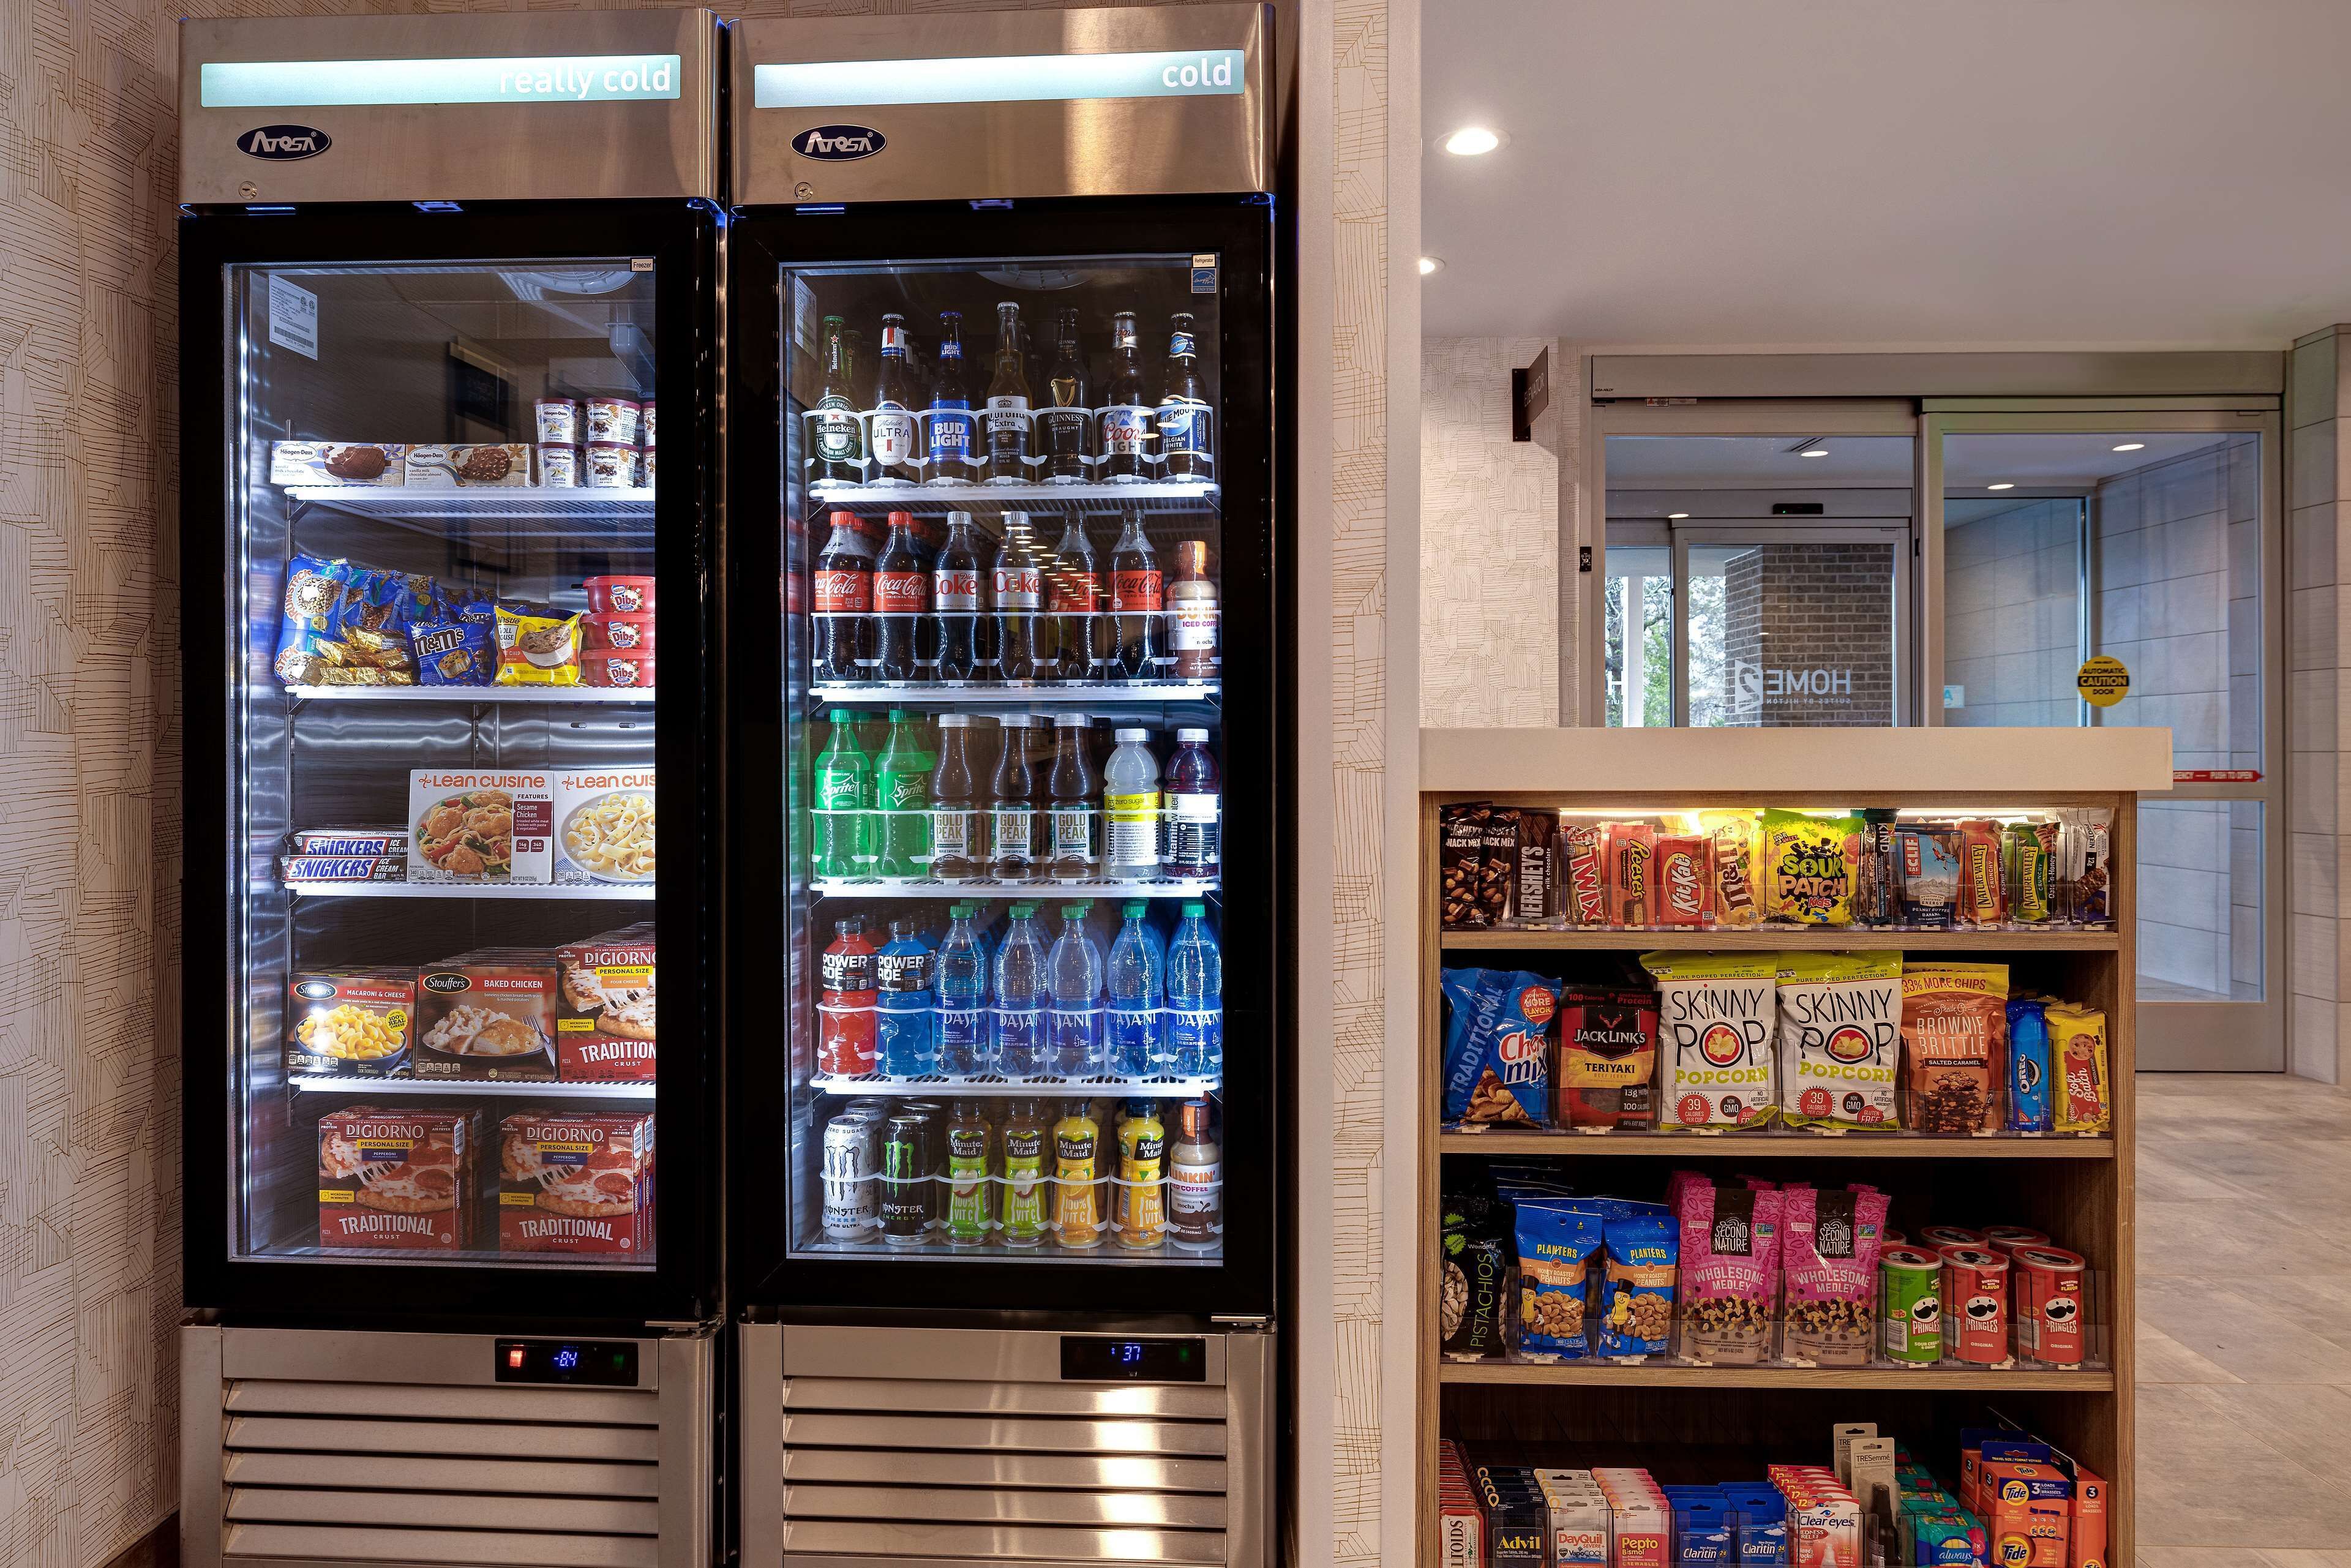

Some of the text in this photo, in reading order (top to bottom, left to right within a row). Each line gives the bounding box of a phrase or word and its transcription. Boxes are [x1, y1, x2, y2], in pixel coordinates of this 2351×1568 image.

[1162, 57, 1232, 88] cold
[499, 62, 670, 99] really cold
[1524, 372, 1545, 407] ELEVATOR
[1048, 415, 1084, 424] GUINNESS
[816, 424, 855, 433] Heineken
[874, 429, 910, 438] ULTRA
[934, 422, 966, 435] BUD
[931, 435, 970, 449] LIGHT
[876, 574, 926, 596] Coca-Cola
[932, 574, 978, 596] Coke
[615, 595, 637, 605] Dibs
[2080, 677, 2127, 686] CAUTION
[894, 784, 926, 799] Sprite
[1000, 813, 1027, 827] GOLD
[1058, 813, 1086, 827] GOLD
[1000, 827, 1028, 839] PEAK
[1059, 827, 1087, 839] PEAK
[1878, 823, 1889, 853] KIND
[1906, 836, 1919, 868] CLIF
[291, 859, 372, 877] SNICKERS
[1782, 855, 1843, 877] SOUR
[1520, 846, 1544, 918] HERSHEY'S
[1779, 875, 1849, 897] PATCH
[1808, 897, 1831, 908] Kids
[822, 953, 868, 968] POWER
[1902, 977, 1987, 993] 33% MORE CHIPS
[1917, 1016, 1984, 1035] BROWNIE
[1574, 1029, 1646, 1043] JACK LINK'S
[1919, 1037, 1986, 1056] BRITTLE
[1584, 1062, 1635, 1074] TERIYAKI
[2019, 1054, 2032, 1095] OREO
[1675, 1066, 1768, 1085] POPCORN
[2069, 1071, 2079, 1097] Soft
[2078, 1067, 2098, 1103] Batch
[1624, 1089, 1638, 1098] 13g
[1687, 1098, 1701, 1111] 39
[1723, 1104, 1739, 1113] GMO
[950, 1139, 981, 1148] Minute
[1060, 1141, 1092, 1150] Minute
[953, 1147, 977, 1156] Maid
[1013, 1147, 1038, 1155] Maid
[1065, 1199, 1086, 1210] 100%
[954, 1210, 973, 1221] VIT C
[339, 1214, 435, 1236] TRADITIONAL
[519, 1219, 613, 1241] TRADITIONAL
[1714, 1224, 1747, 1238] SECOND
[1537, 1244, 1578, 1259] PLANTERS
[1714, 1237, 1748, 1253] NATURE
[1630, 1248, 1667, 1259] PLANTERS
[1540, 1274, 1571, 1285] PEANUTS
[1694, 1266, 1766, 1286] WHOLESOME
[1712, 1280, 1752, 1292] MEDLEY
[1470, 1253, 1493, 1347] PISTACHIOS
[2045, 1319, 2077, 1335] PRINGLES
[1123, 1346, 1141, 1361] 37
[1856, 1454, 1890, 1463] TRESemmé
[2005, 1487, 2027, 1501] Tide
[2031, 1482, 2040, 1495] 3
[1799, 1515, 1854, 1528] Clear eyes
[1496, 1536, 1542, 1550] Advil
[1558, 1533, 1603, 1547] DayQuil
[1622, 1537, 1659, 1550] Pepto
[1683, 1547, 1717, 1559] Claritin
[1938, 1550, 1973, 1561] always
